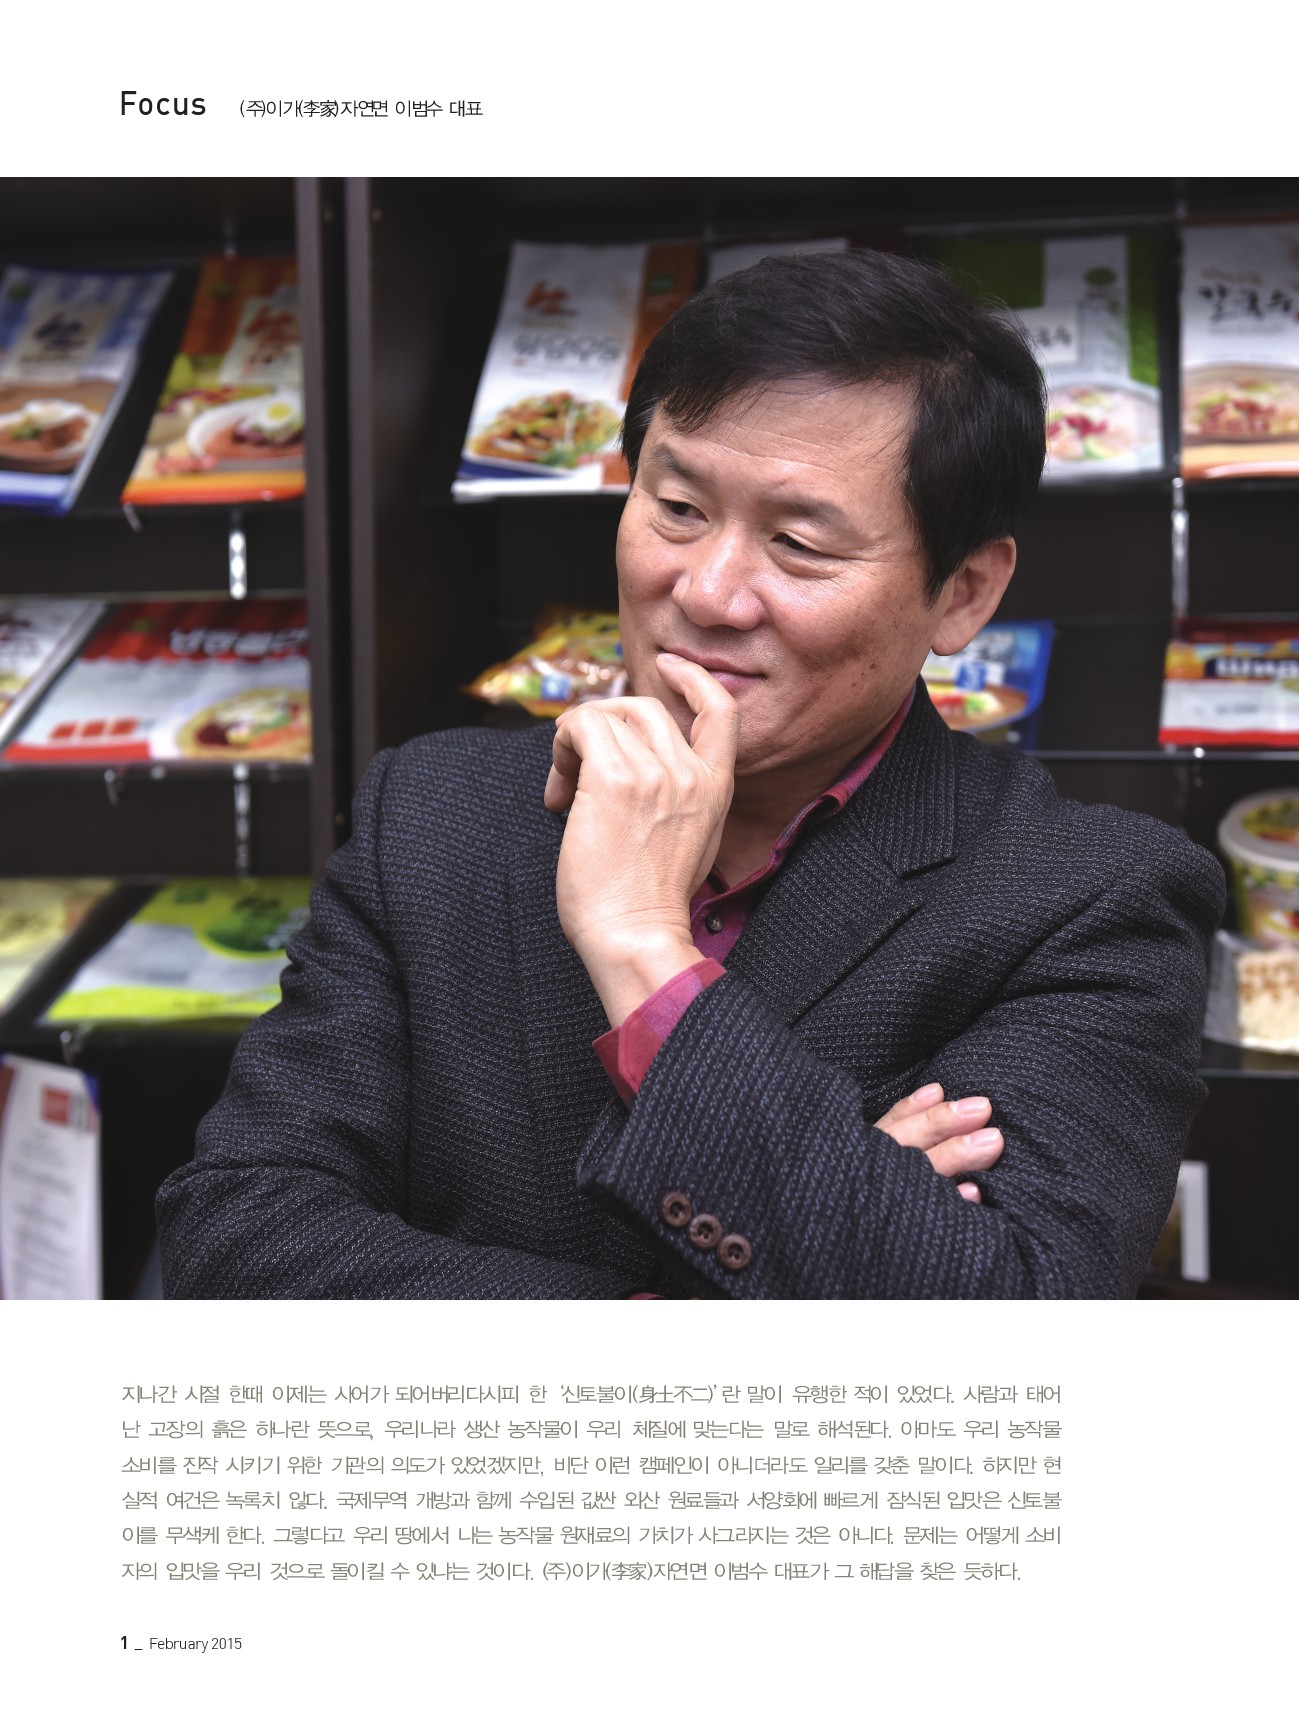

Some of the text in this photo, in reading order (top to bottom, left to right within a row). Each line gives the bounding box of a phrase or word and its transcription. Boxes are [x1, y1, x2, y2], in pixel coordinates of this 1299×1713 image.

[120, 90, 206, 116] Focus
[395, 99, 444, 118] 이범수
[449, 99, 484, 118] 대표
[122, 1419, 1063, 1441] 난 고장의 흙은 하나란 뜻으로, 우리나라 생산 농작물이 우리 체질에 맞는다는 말로 해석된다. 아마도 우리 농작물
[121, 1490, 1063, 1510] 실적 여건은 녹록치 않다. 국제무역 개방과 함께 수입된 값싼 외산 원료들과 서양화에 빠르게 잠식된 입맛은 신토불
[121, 1561, 157, 1581] 자의
[166, 1561, 221, 1581] 입맛을
[225, 1561, 261, 1581] 우리
[270, 1561, 326, 1581] 것으로
[330, 1561, 385, 1581] 돌이킬
[390, 1562, 411, 1581] 수
[416, 1561, 471, 1581] 있냐는
[476, 1561, 534, 1581] 것이다.
[714, 1561, 769, 1581] 이범수
[774, 1561, 830, 1581] 대표가
[834, 1564, 855, 1578] 그
[859, 1561, 915, 1581] 해답을
[919, 1561, 957, 1581] 찾은
[963, 1561, 1021, 1581] 듯하다.
[120, 1635, 242, 1654] 1 February 2015
